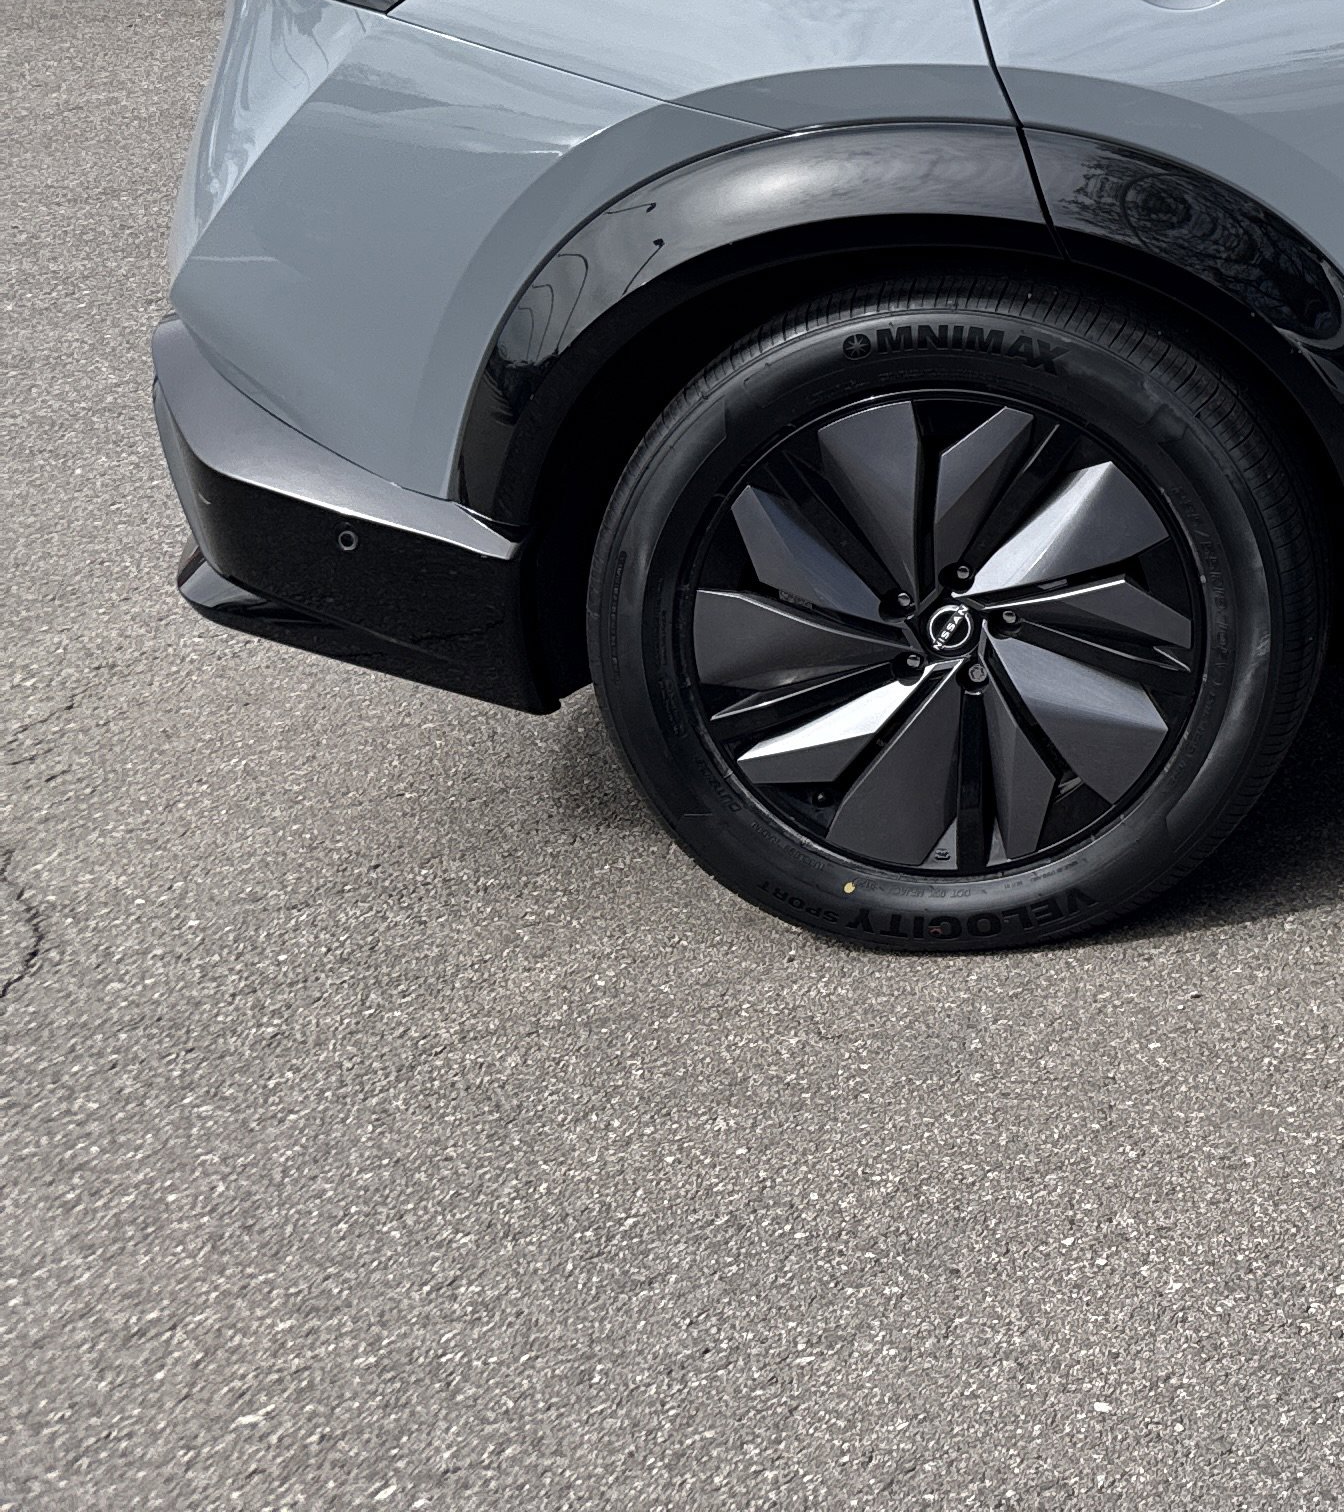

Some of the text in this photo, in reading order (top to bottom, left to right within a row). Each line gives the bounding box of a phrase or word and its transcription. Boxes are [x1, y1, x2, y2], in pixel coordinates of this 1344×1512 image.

[933, 603, 969, 651] NISSAN
[758, 881, 1100, 938] VELOCITY SPORT
